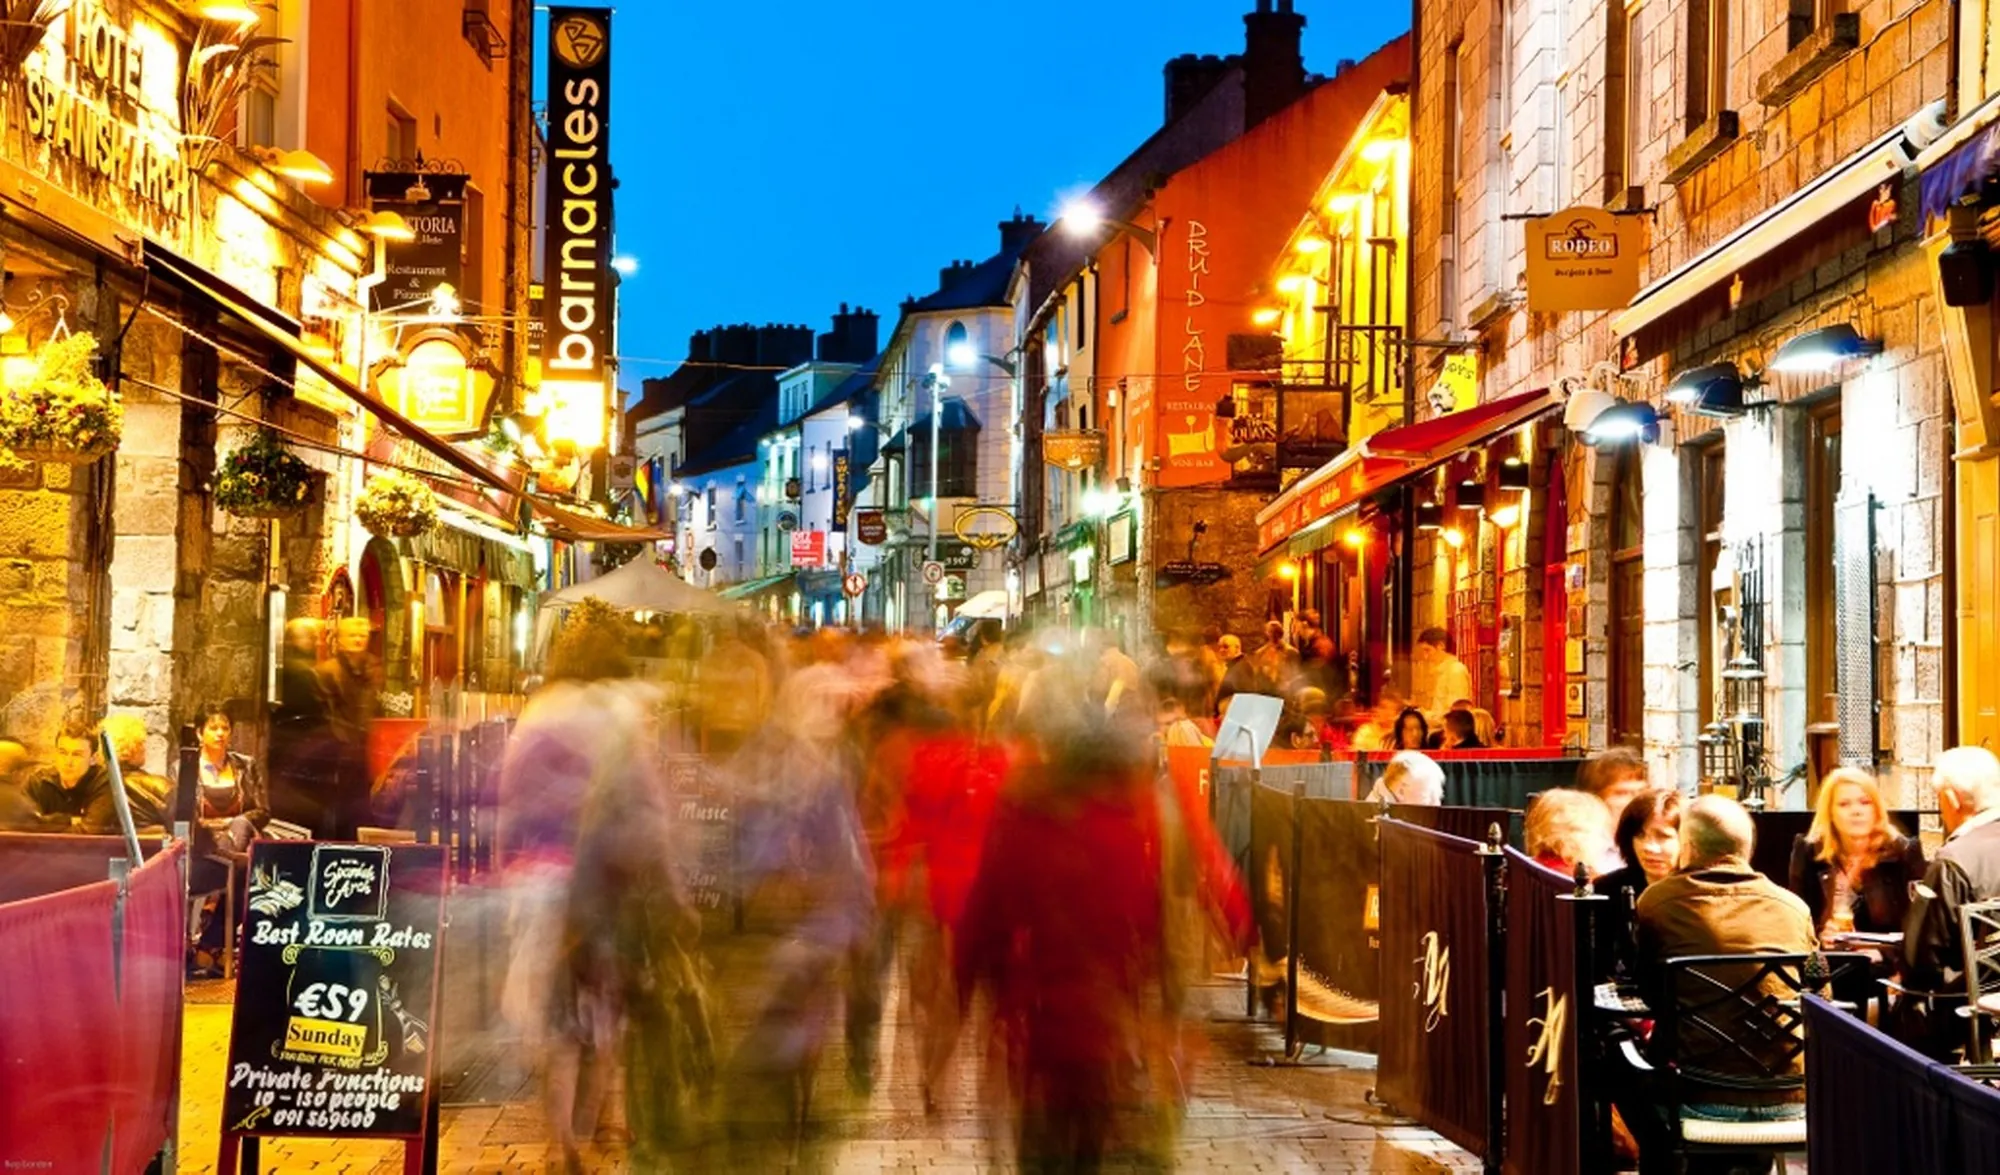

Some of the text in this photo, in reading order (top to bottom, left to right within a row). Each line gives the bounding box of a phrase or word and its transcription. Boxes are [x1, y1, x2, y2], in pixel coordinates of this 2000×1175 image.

[26, 65, 190, 219] SPANISH ARCH
[549, 78, 601, 371] barnacles
[1551, 238, 1611, 254] RODEO
[387, 263, 447, 276] Restaurant
[408, 276, 420, 288] &
[393, 288, 433, 300] Pizzeri
[1183, 220, 1210, 392] DRUID LANE
[1196, 459, 1214, 467] BAR
[677, 802, 729, 821] Music
[323, 859, 376, 889] Spanish
[325, 880, 372, 908] Arch
[251, 921, 432, 949] Best Room Rates
[294, 982, 369, 1023] €59
[288, 1024, 364, 1053] Sunday
[229, 1063, 425, 1093] Private Functions
[253, 1090, 276, 1107] 10
[328, 1090, 401, 1113] people
[273, 1109, 377, 1131] 091 569600
